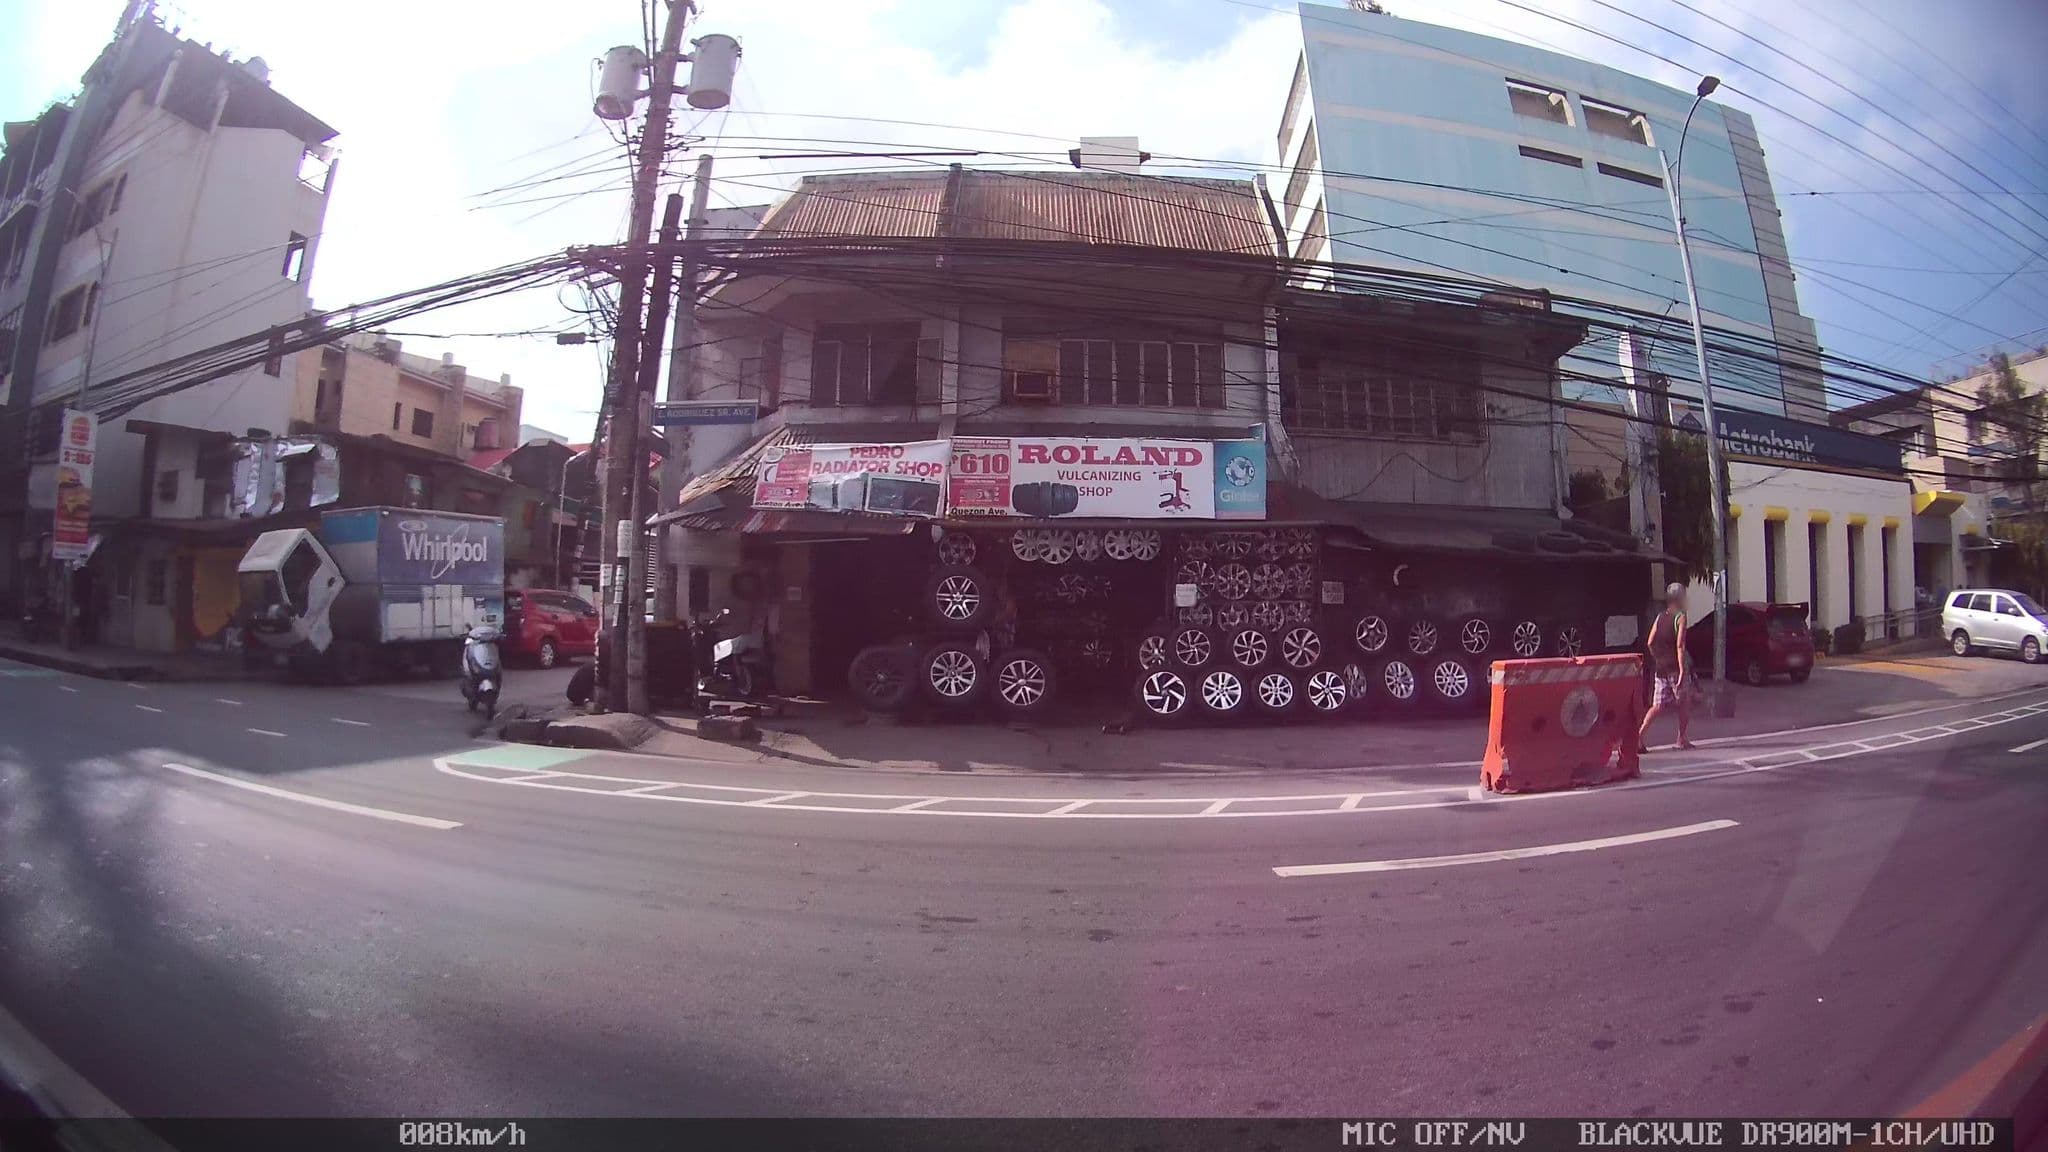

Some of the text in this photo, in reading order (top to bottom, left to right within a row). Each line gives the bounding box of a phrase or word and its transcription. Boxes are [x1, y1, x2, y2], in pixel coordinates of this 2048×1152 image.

[851, 446, 904, 459] PEDRO
[1018, 444, 1203, 467] ROLAND
[812, 460, 890, 475] RADIATOR
[895, 461, 944, 477] SHOP
[1057, 470, 1142, 482] VULCANIZING
[1079, 486, 1113, 497] SHOP
[951, 507, 1008, 516] Quezon Ave.
[401, 532, 487, 569] Whirlpool
